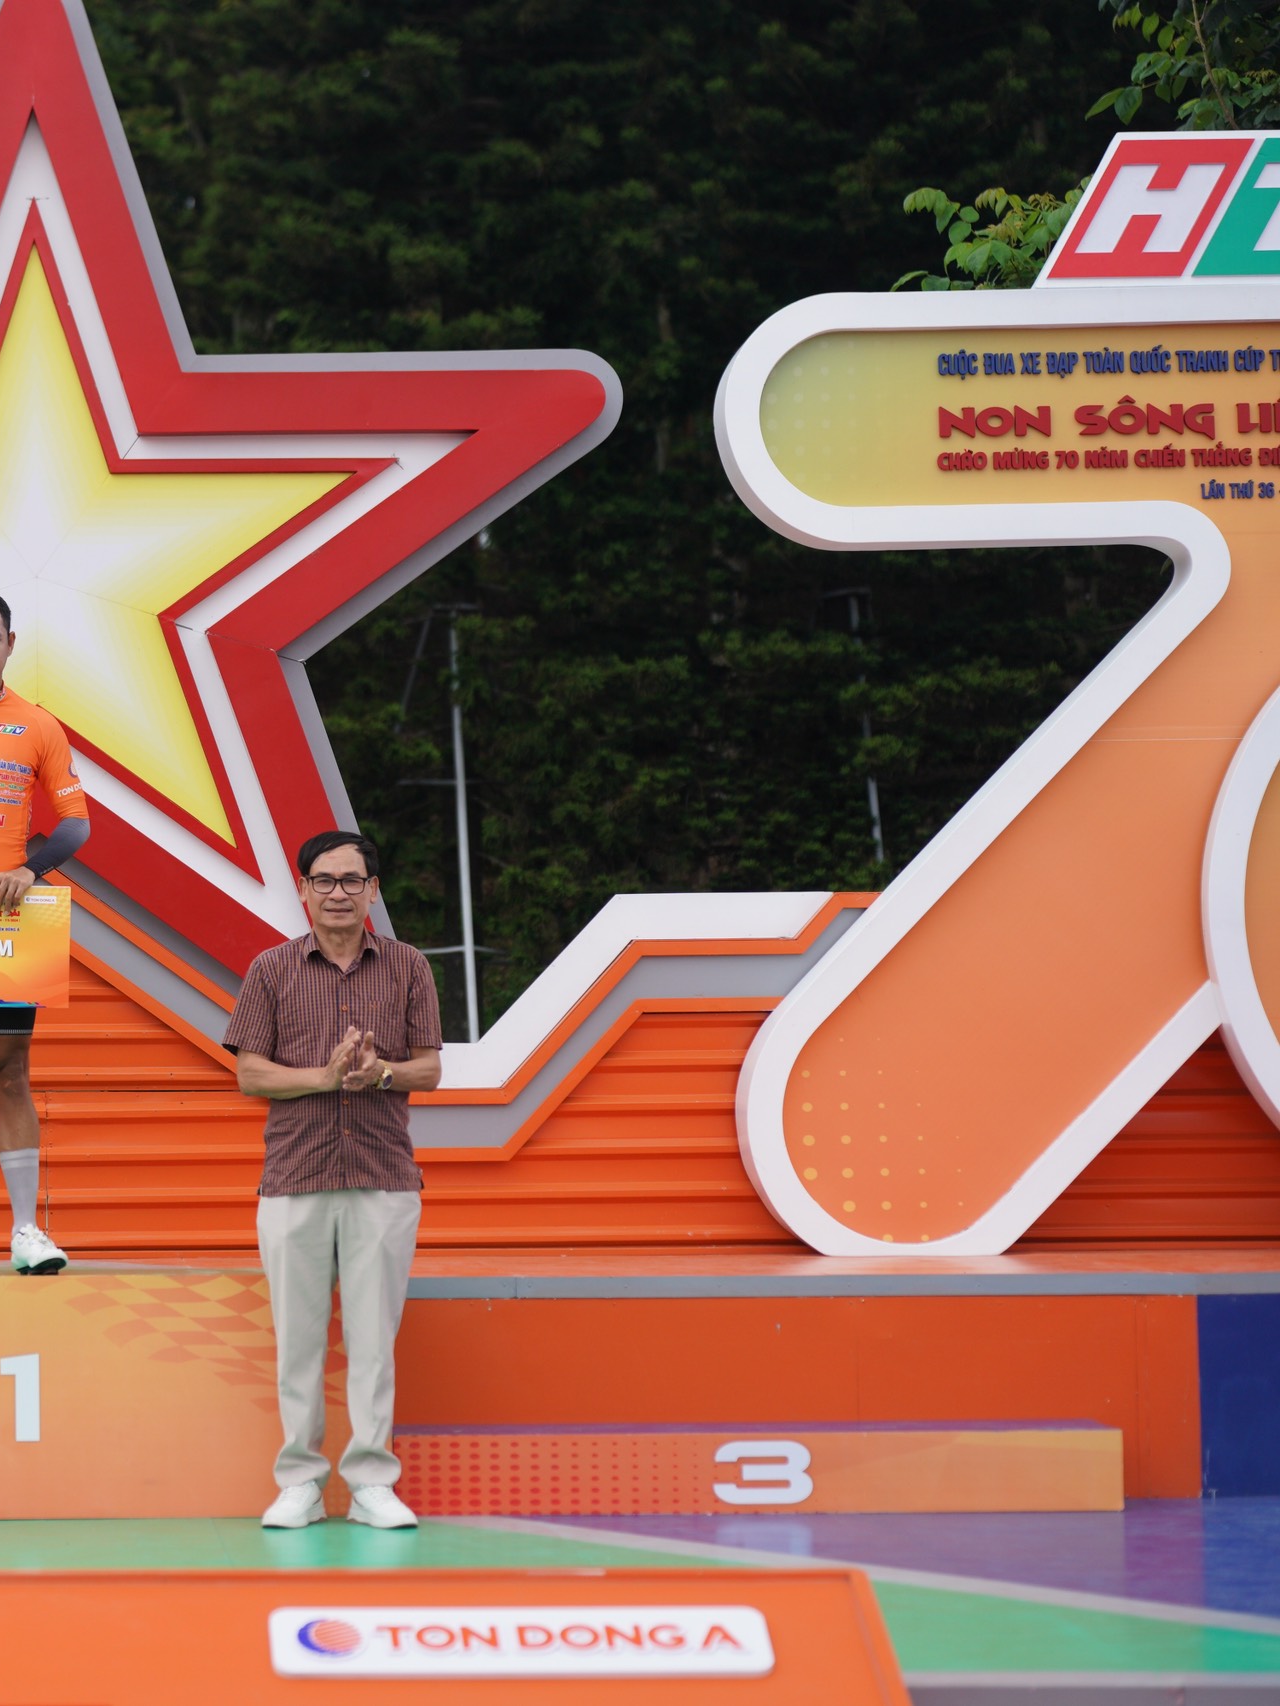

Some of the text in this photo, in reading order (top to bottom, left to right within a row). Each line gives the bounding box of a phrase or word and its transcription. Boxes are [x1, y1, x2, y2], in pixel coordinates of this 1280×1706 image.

[1074, 163, 1280, 254] H
[937, 349, 979, 380] CUỘC
[983, 353, 1016, 376] ĐUA
[1020, 352, 1042, 375] XE
[1046, 352, 1079, 379] ĐẠP
[1083, 347, 1125, 374] TOÀN
[1130, 345, 1172, 374] QUỐC
[1176, 350, 1229, 373] TRANH
[1234, 346, 1265, 372] CÚP
[938, 405, 1052, 438] NON
[1074, 394, 1216, 440] SÔNG
[1055, 450, 1080, 469] 70
[1084, 446, 1129, 469] NĂM
[1134, 443, 1186, 469] CHIẾN
[1191, 441, 1253, 468] THẮNG
[1258, 446, 1280, 469] ĐI
[1229, 479, 1254, 499] THỨ
[1258, 481, 1275, 499] 36
[56, 786, 74, 797] TON
[0, 1354, 40, 1442] 1
[713, 1440, 814, 1505] 3
[376, 1625, 743, 1650] TON DONG A
